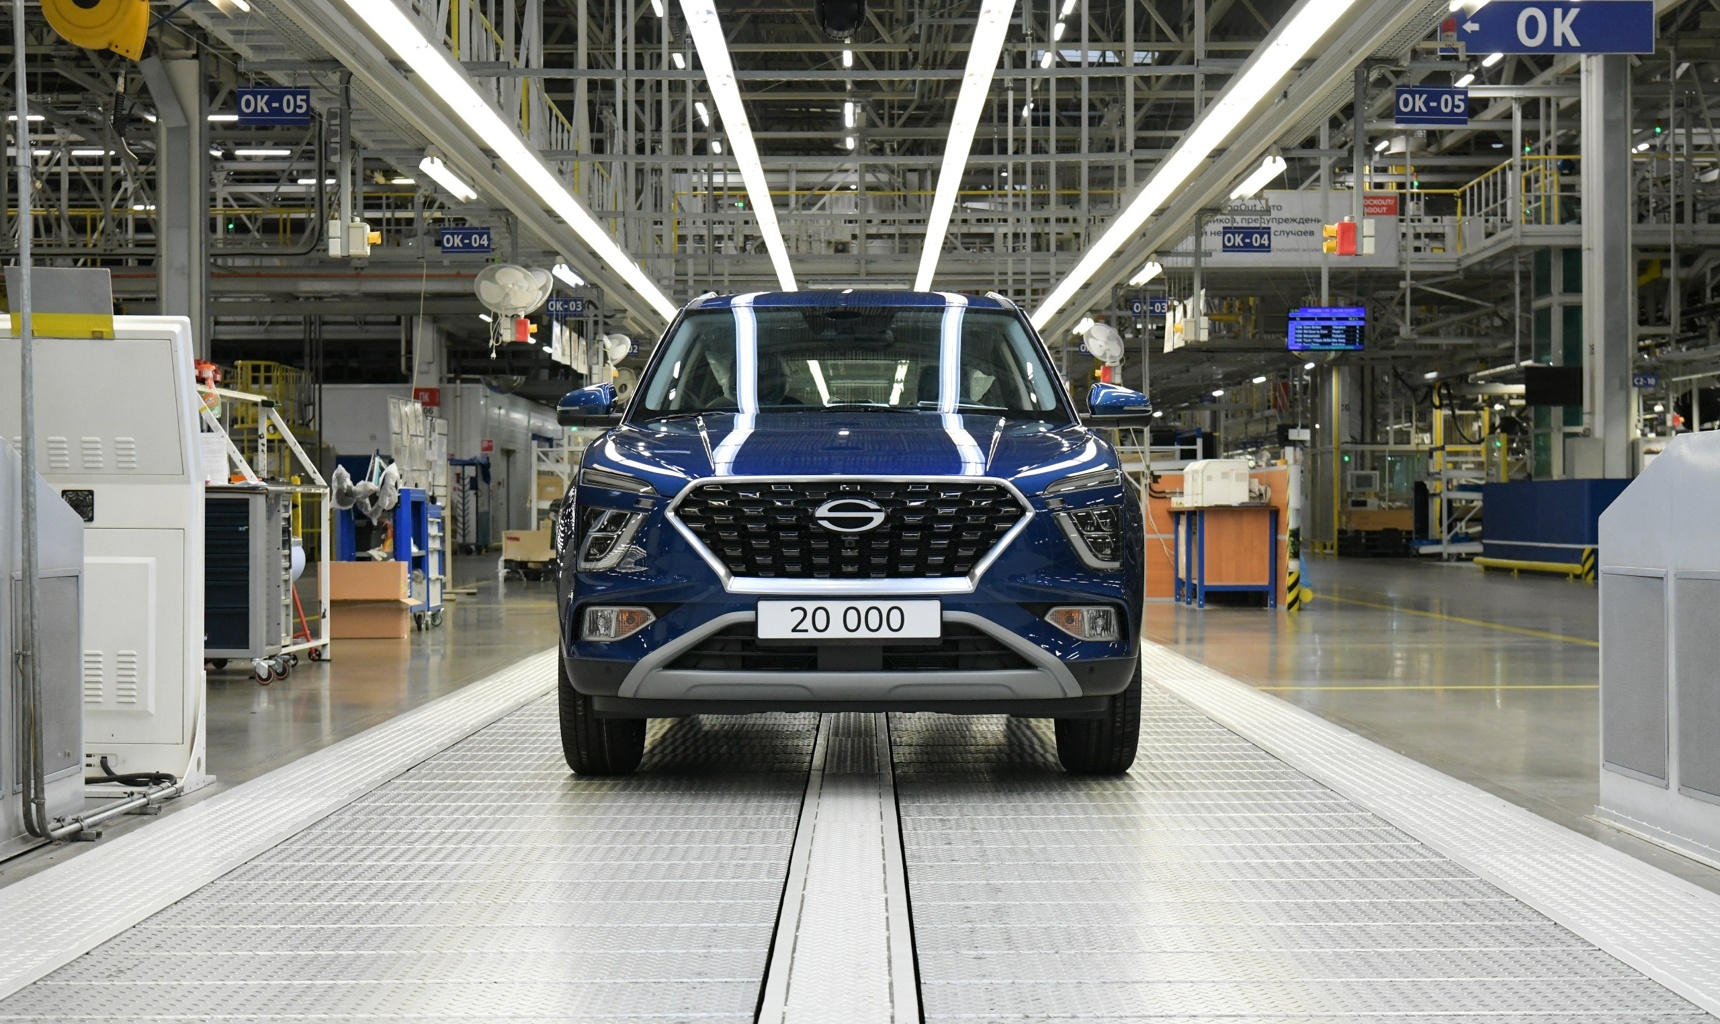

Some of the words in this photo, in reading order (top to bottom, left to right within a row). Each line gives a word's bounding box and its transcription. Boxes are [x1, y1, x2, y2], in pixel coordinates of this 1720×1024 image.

[1516, 7, 1581, 48] OK
[241, 94, 307, 113] OK-05
[1399, 93, 1465, 113] OK-05
[443, 234, 489, 248] OK-04
[1224, 233, 1270, 247] OK-04
[1273, 230, 1315, 238] случаев
[548, 301, 582, 312] OK-03
[790, 606, 831, 633] 20
[842, 606, 905, 633] 000
